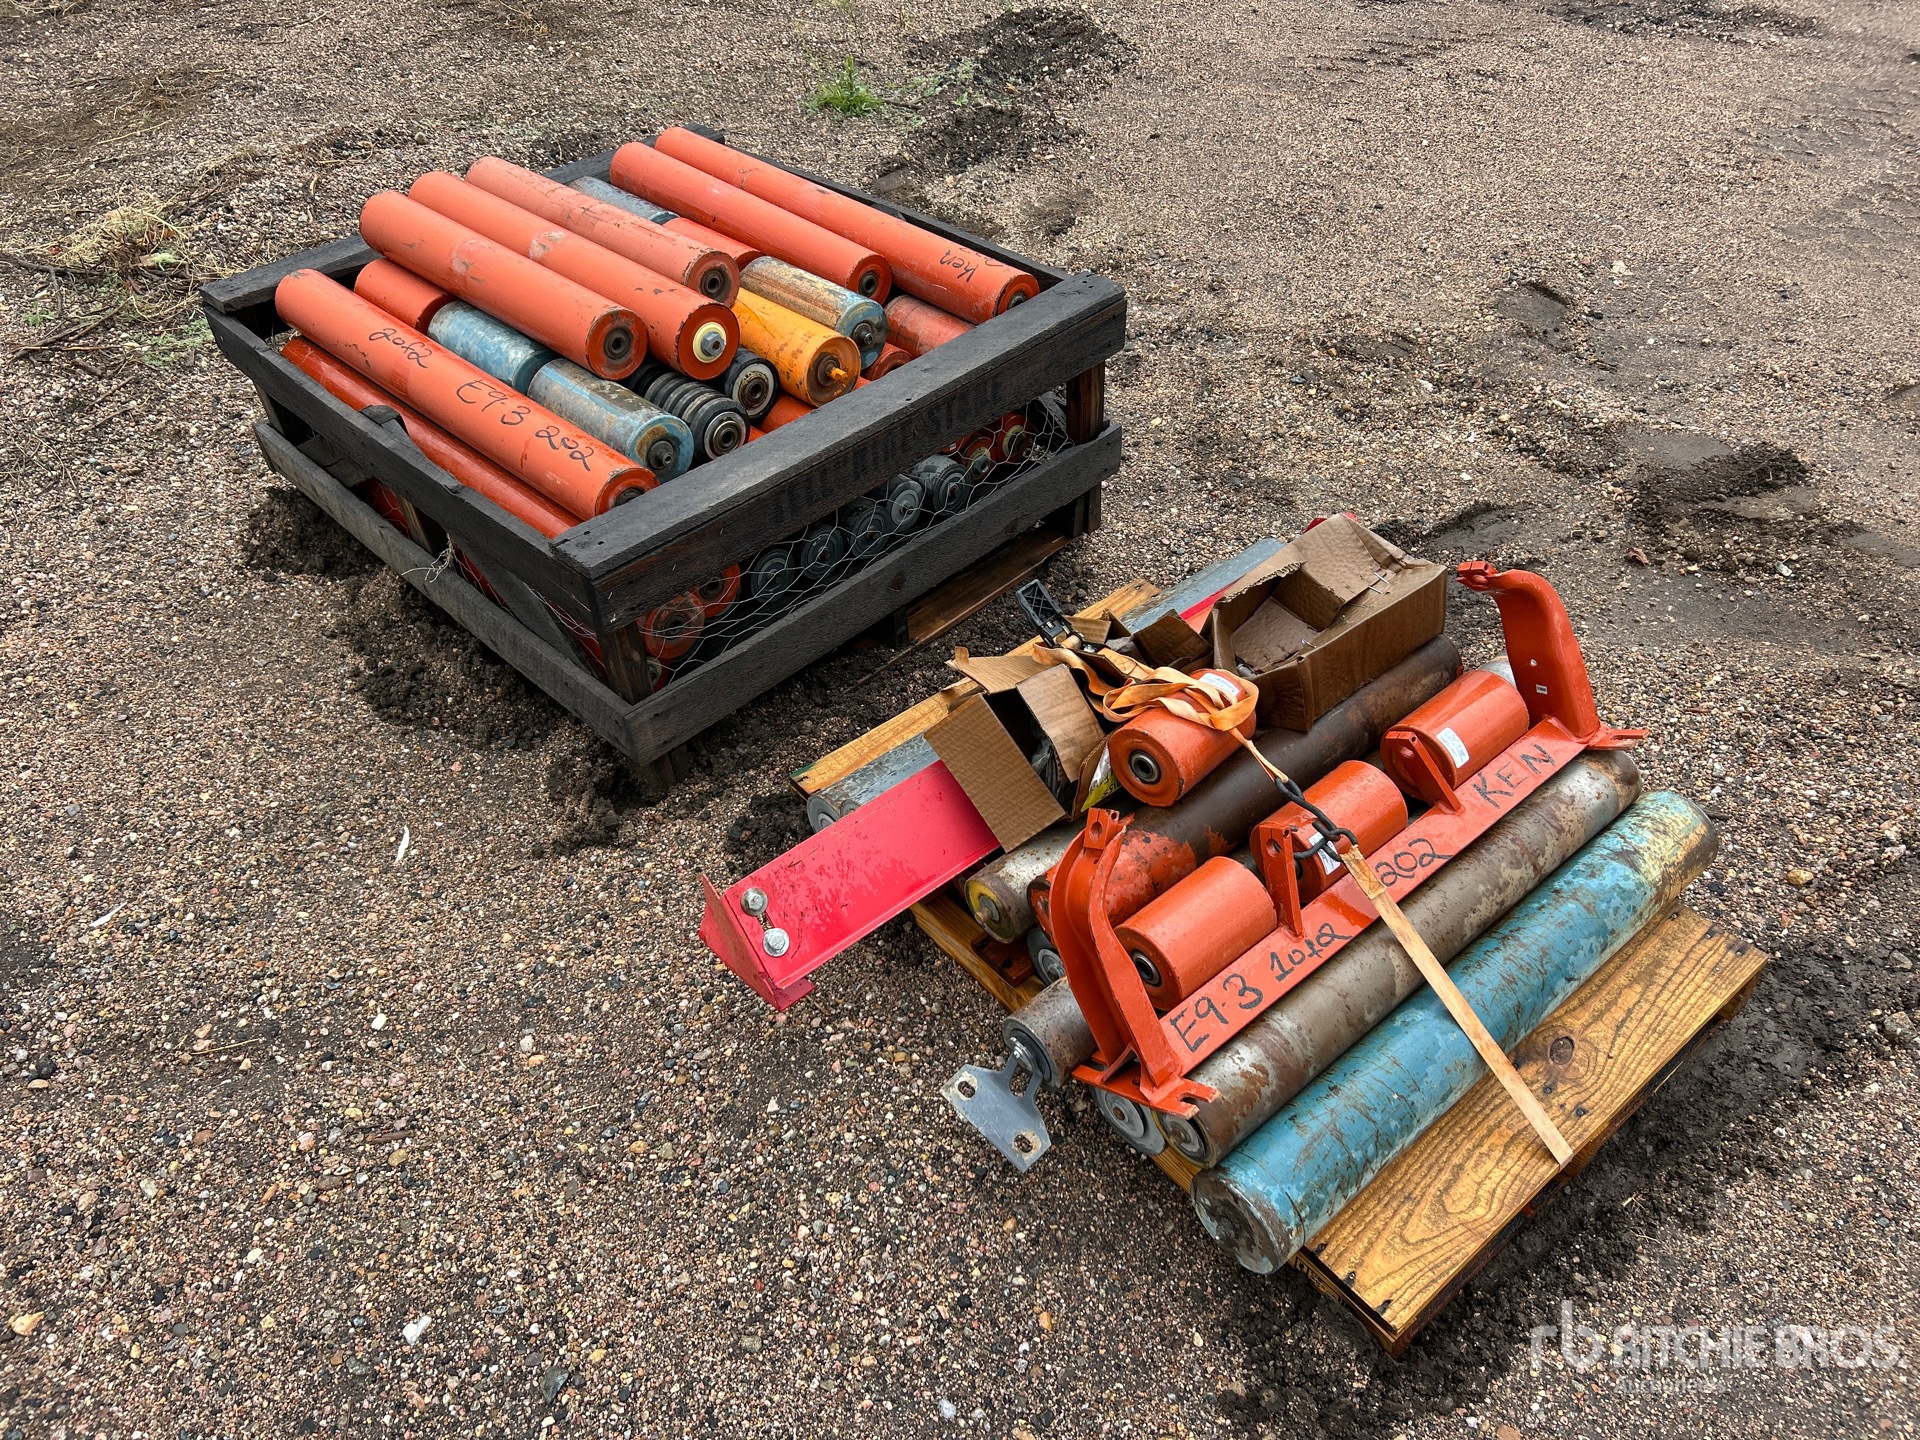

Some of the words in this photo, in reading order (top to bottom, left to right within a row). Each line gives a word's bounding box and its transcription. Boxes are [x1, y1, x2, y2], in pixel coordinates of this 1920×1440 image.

[535, 425, 595, 472] 202
[1374, 837, 1454, 888] 202
[1472, 743, 1556, 809] KEN
